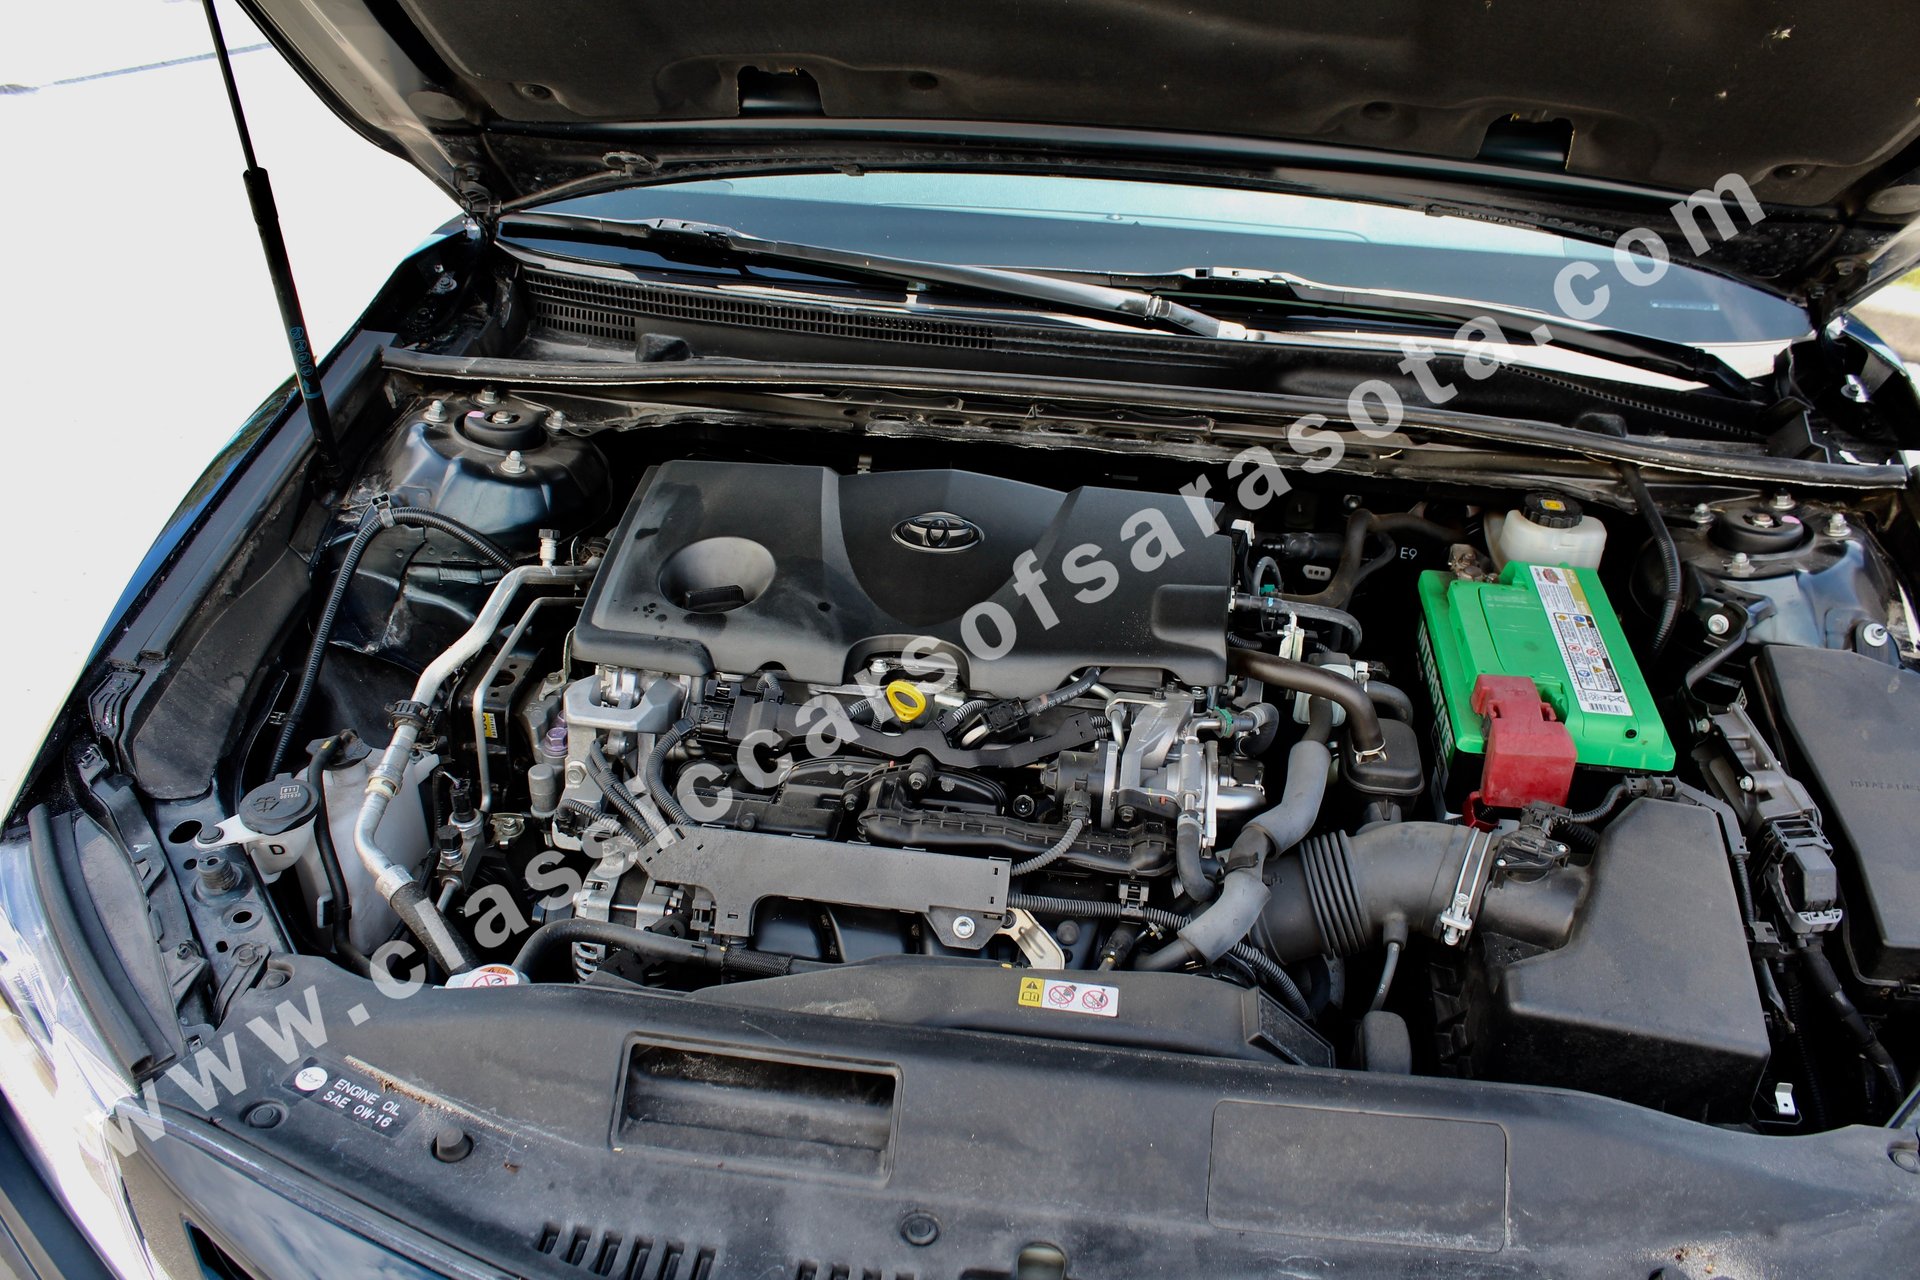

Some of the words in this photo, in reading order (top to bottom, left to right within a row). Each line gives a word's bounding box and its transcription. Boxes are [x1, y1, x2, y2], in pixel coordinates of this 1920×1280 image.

[1400, 546, 1418, 560] E9
[1418, 619, 1454, 758] INTERSTATE
[269, 844, 286, 856] D
[323, 1090, 351, 1109] SAE
[334, 1078, 380, 1105] ENGINE
[382, 1100, 401, 1117] OIL
